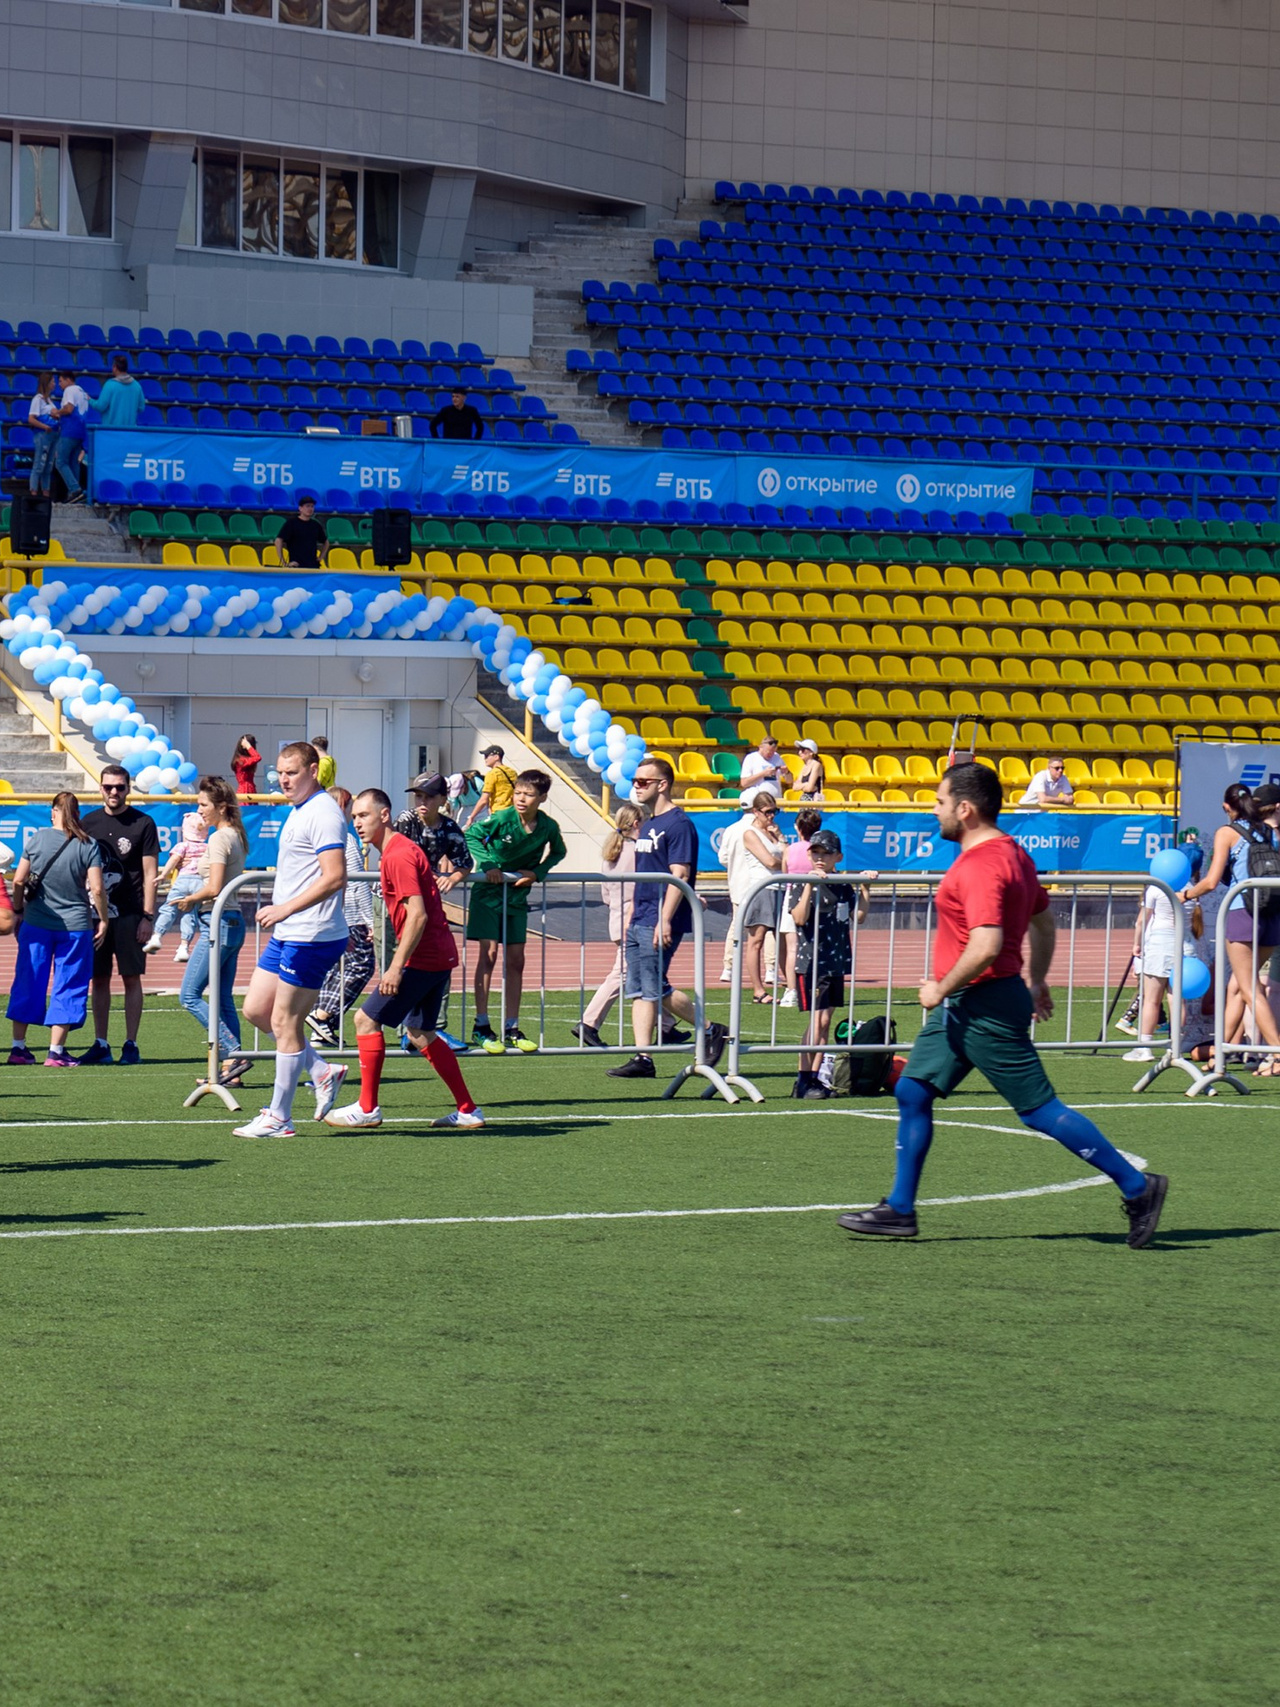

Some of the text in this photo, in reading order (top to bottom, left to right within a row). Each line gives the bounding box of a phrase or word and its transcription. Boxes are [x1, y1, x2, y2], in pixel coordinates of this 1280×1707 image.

[144, 458, 401, 489] ВТБ ВТБ ВТБ
[471, 470, 713, 500] ВТБ ВТБ ВТБ
[785, 475, 1016, 503] открытие открытие
[885, 831, 933, 857] ВТБ
[1145, 833, 1174, 859] ВТ
